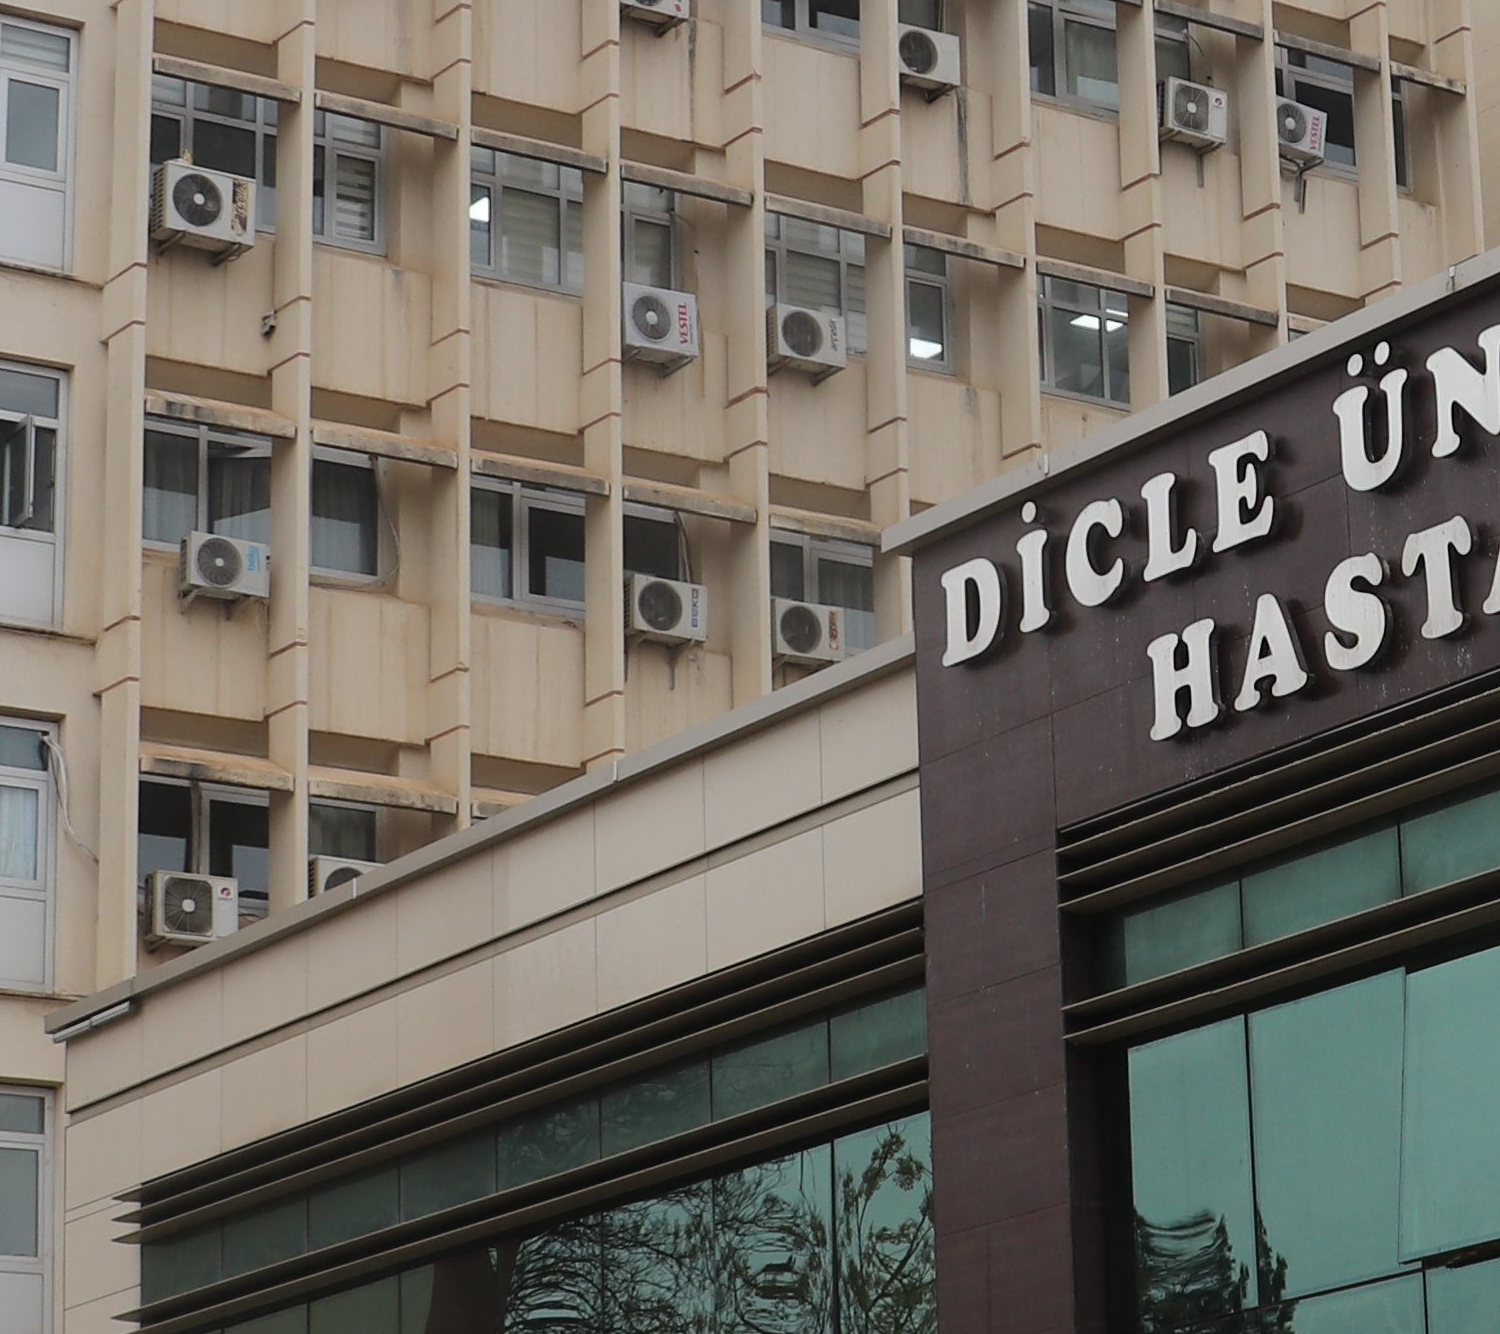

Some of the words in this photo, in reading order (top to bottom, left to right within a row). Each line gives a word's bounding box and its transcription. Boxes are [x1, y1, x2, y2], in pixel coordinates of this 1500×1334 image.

[1309, 116, 1322, 151] VESTEL
[678, 302, 689, 345] VESTEL
[941, 429, 1275, 667] DİCLE
